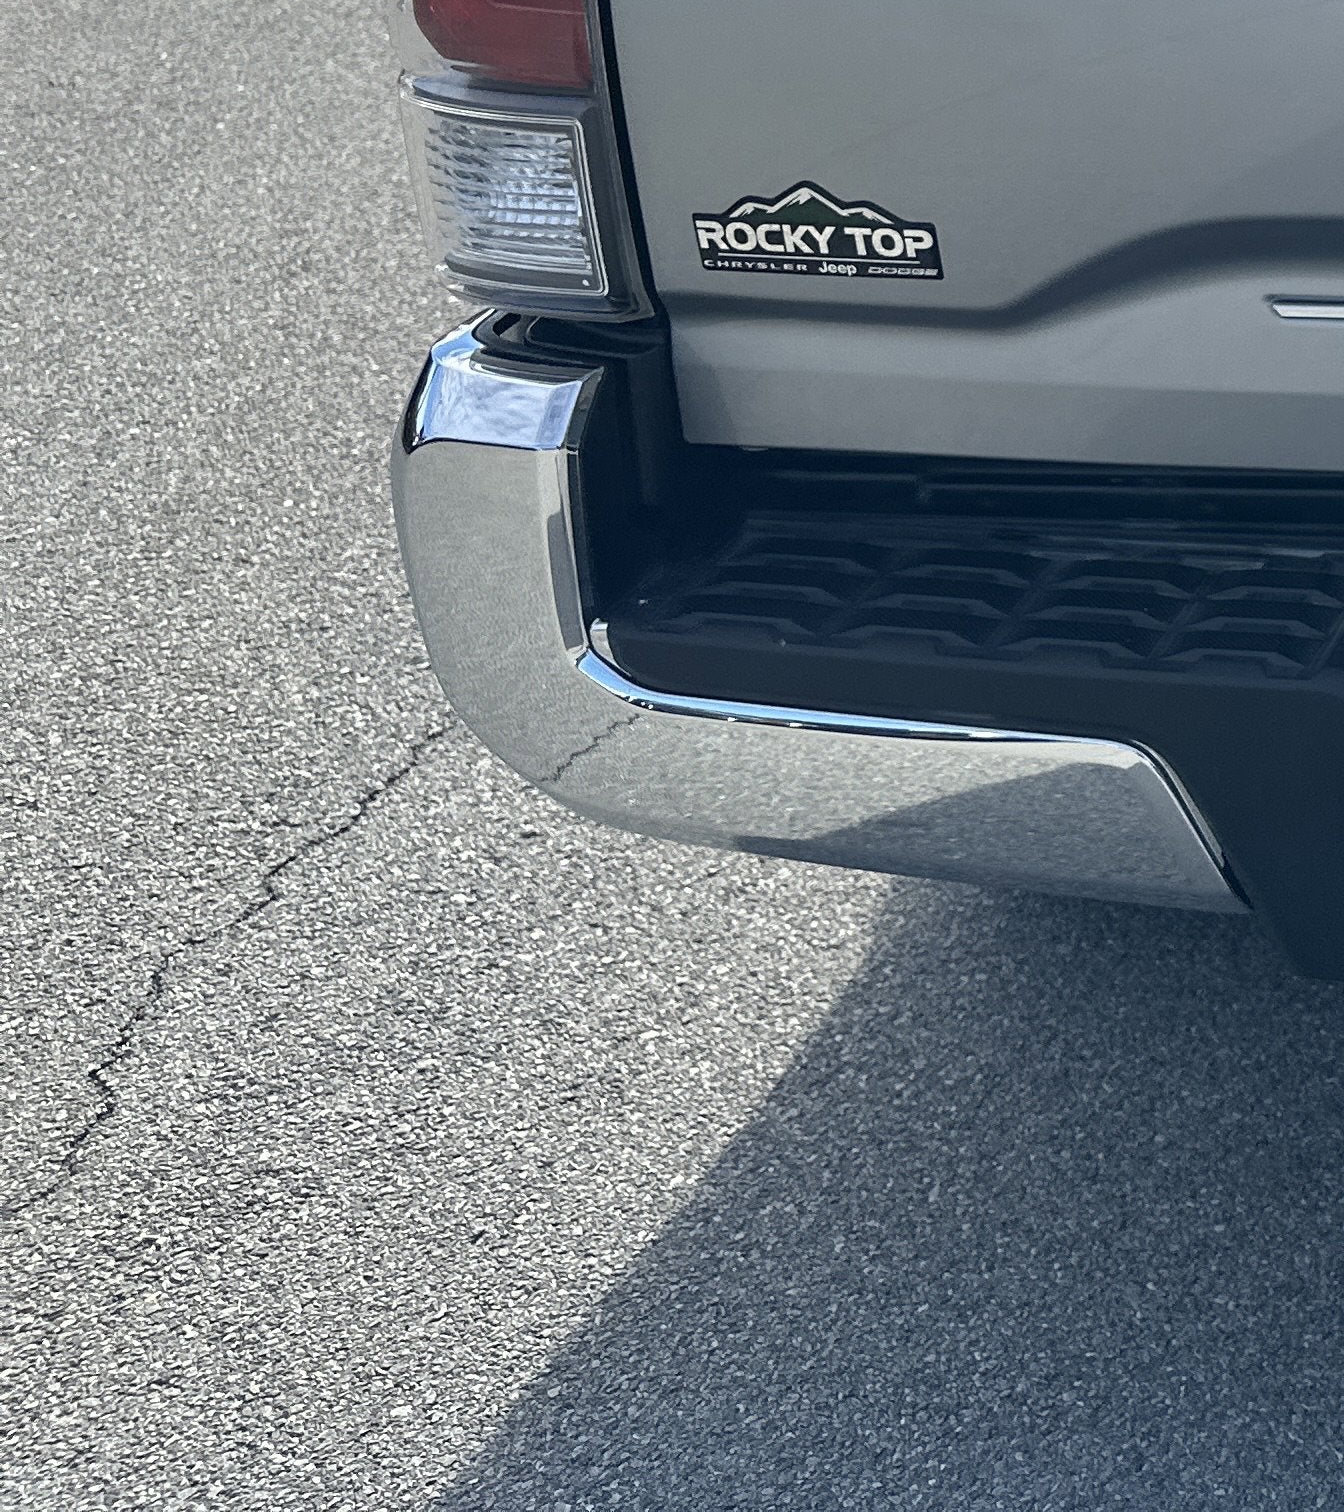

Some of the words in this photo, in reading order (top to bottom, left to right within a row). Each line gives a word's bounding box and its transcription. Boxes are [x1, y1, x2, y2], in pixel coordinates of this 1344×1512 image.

[695, 220, 836, 254] ROCKY
[843, 227, 934, 258] TOP
[703, 259, 808, 271] CHRYSLER
[819, 261, 857, 276] Jeep
[868, 266, 939, 276] DODGE
